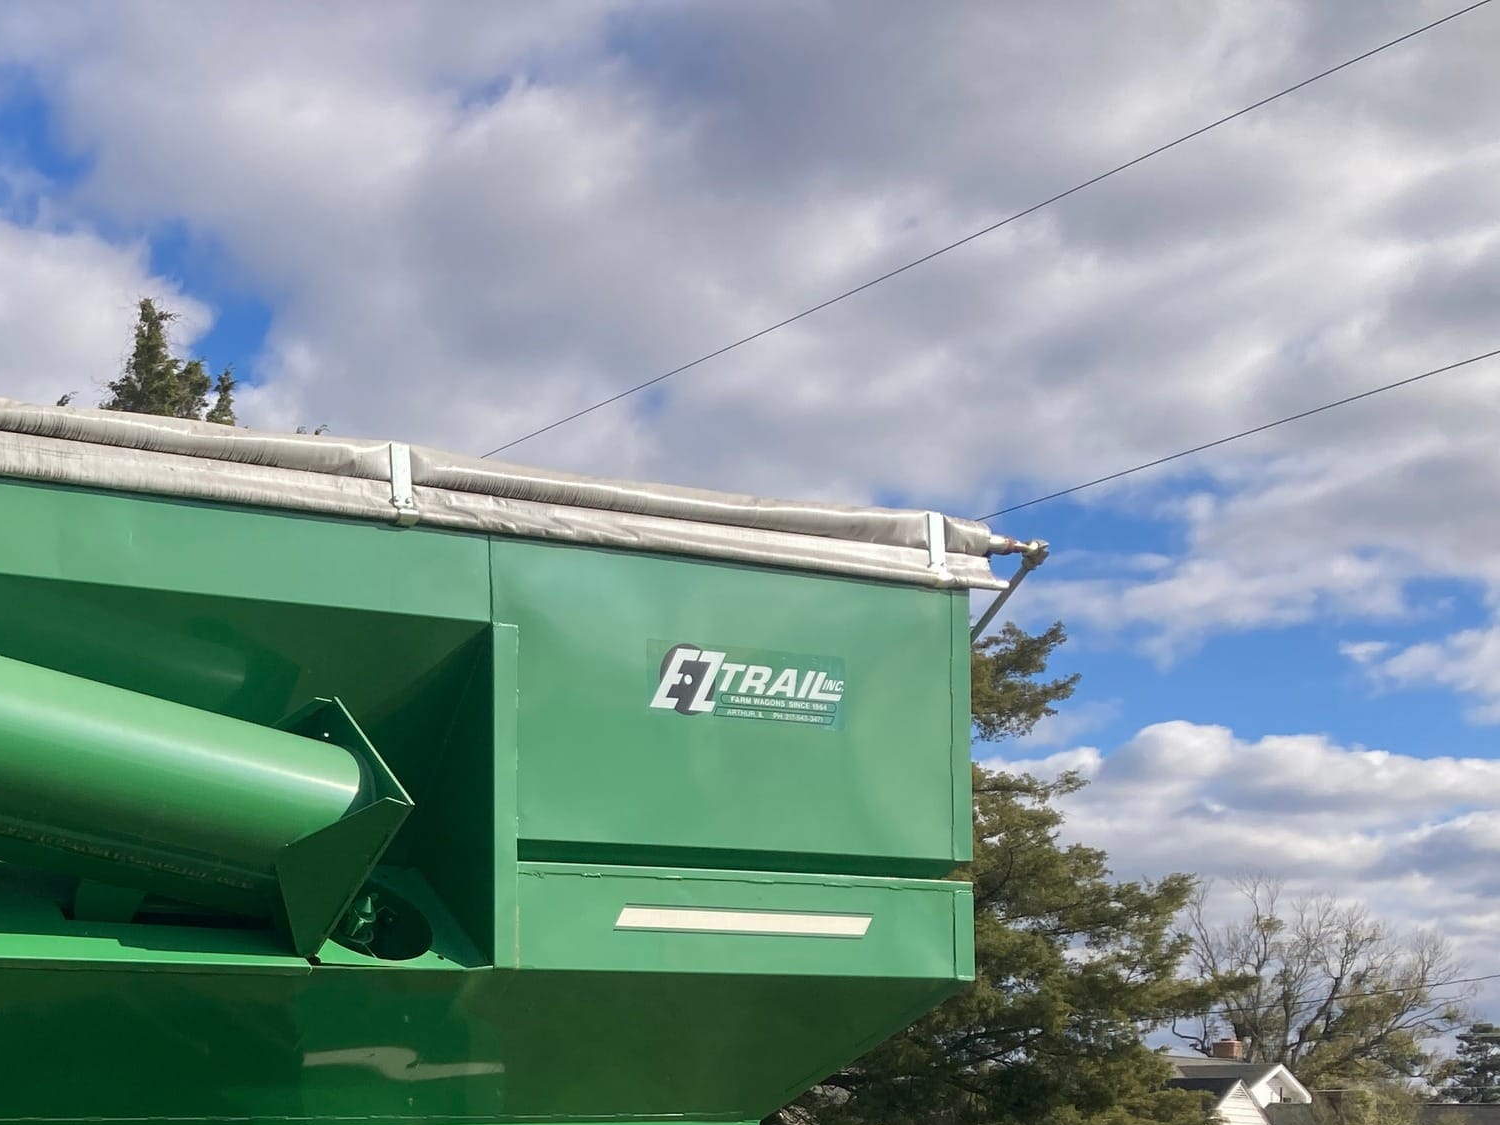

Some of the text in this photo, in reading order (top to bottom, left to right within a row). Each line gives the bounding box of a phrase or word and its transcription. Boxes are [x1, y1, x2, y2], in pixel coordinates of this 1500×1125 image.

[719, 662, 843, 702] TRAIL
[822, 679, 845, 693] INC.
[730, 695, 752, 705] FARM
[753, 698, 786, 708] WAGONS
[788, 701, 810, 710] SINCE
